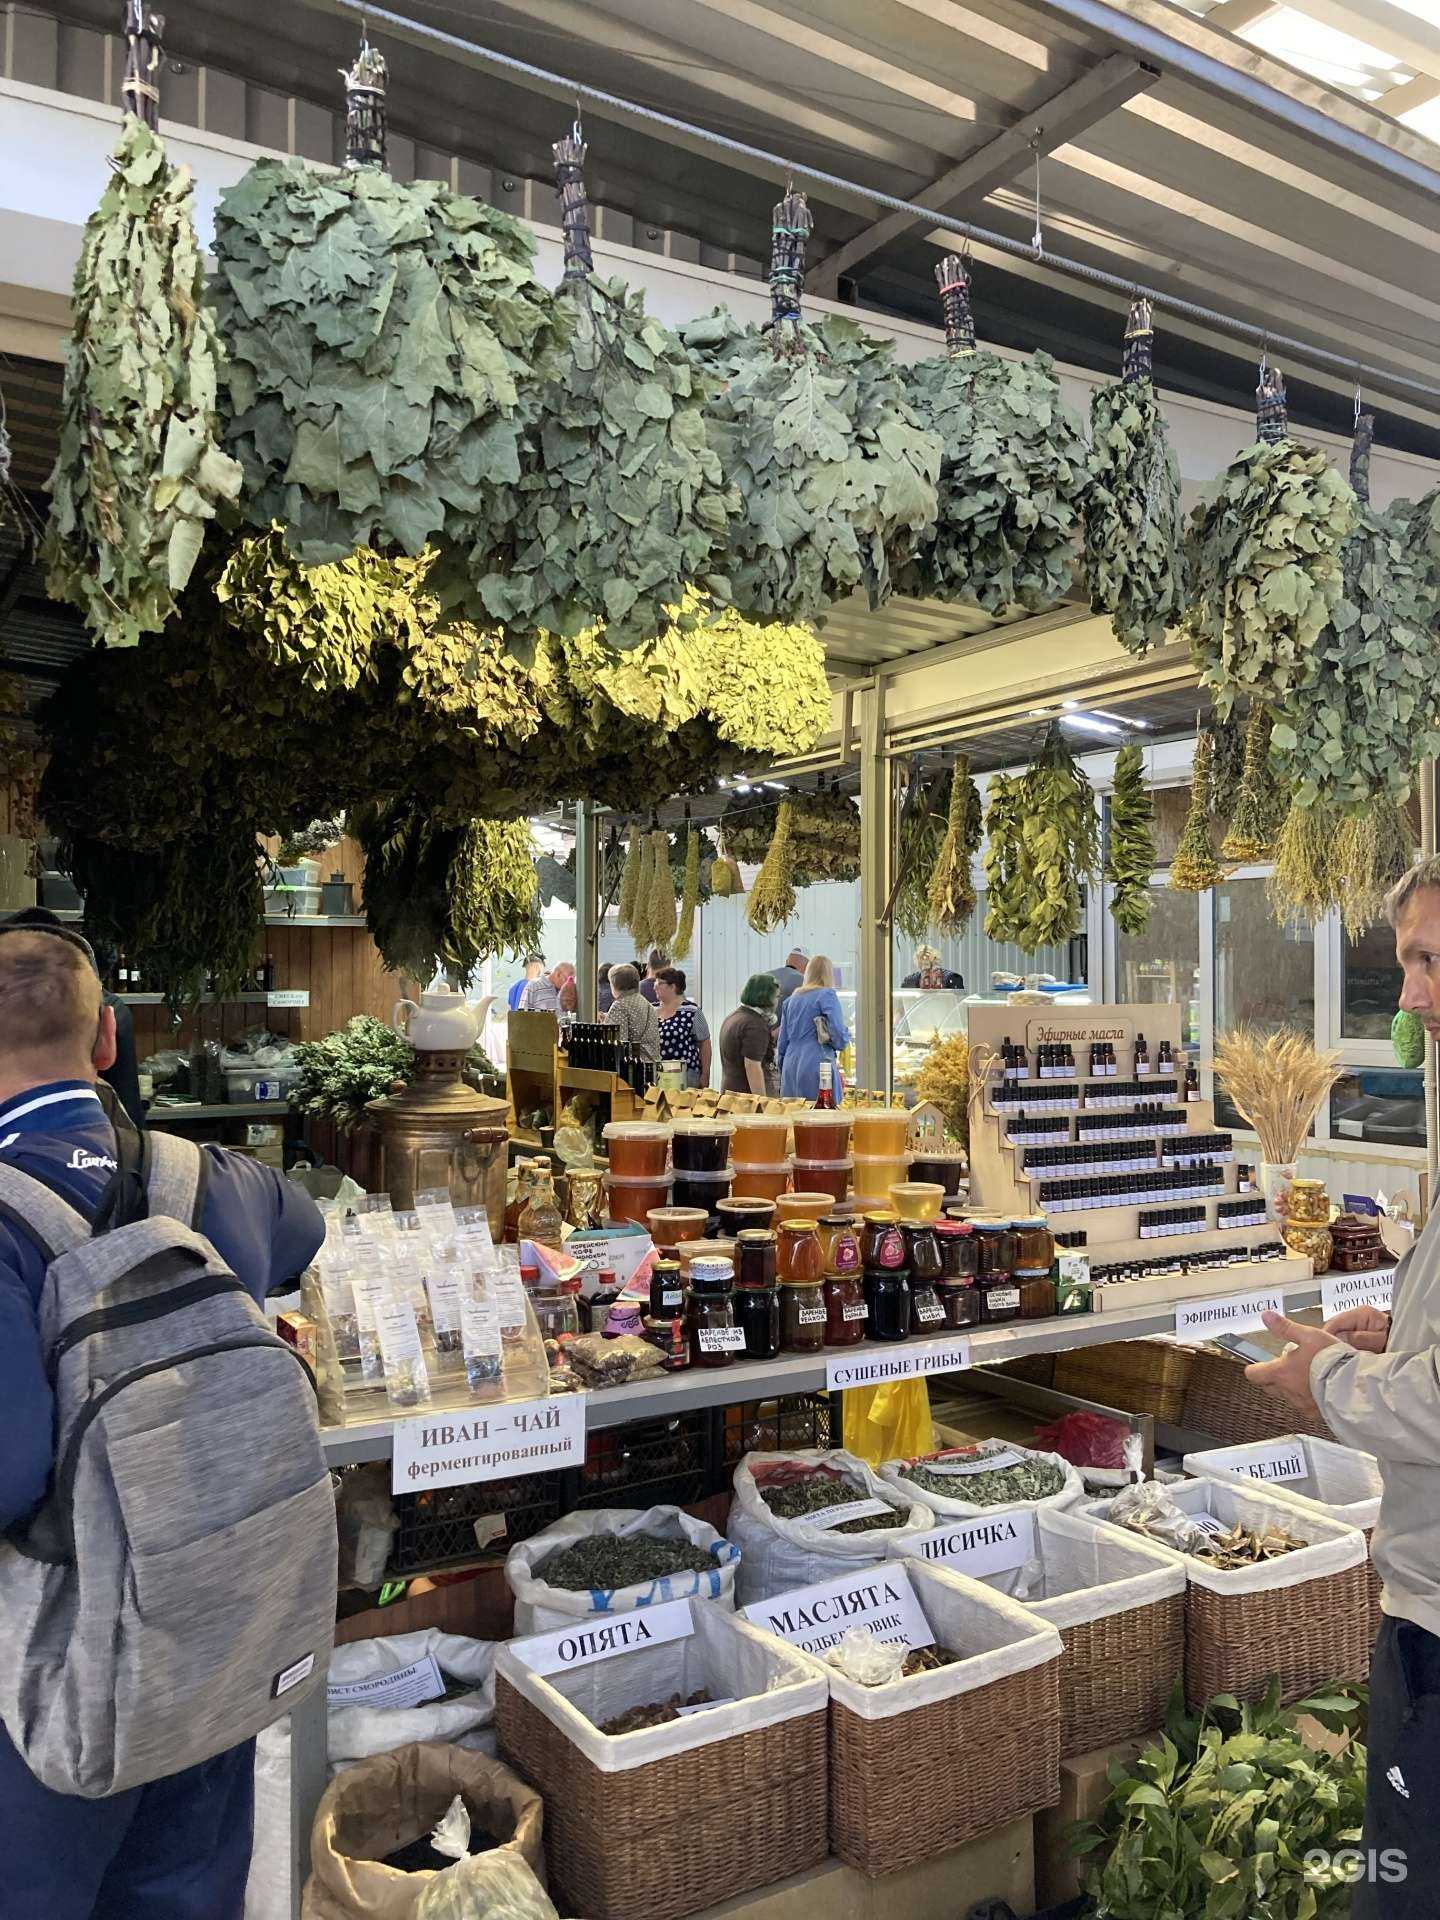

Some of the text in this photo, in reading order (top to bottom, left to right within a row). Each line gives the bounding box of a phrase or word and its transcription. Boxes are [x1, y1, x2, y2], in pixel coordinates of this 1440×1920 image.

[1037, 1026, 1125, 1044] Эфирные масла
[1183, 1299, 1278, 1325] ЭФИРНЫЕ МАСЛА
[834, 1352, 962, 1384] СУШЕНЫЕ ГРИБЫ
[421, 1420, 489, 1448] ИВАН
[513, 1406, 561, 1433] ЧАЙ
[408, 1437, 573, 1479] ферментированный
[1250, 1455, 1301, 1479] БЕЛЫЙ
[920, 1520, 1018, 1560] ЛИСИЧКА
[768, 1582, 903, 1637] МАСЛЯТА
[558, 1619, 652, 1662] ОПЯТА
[352, 1667, 417, 1693] СМОРОДИНЫ
